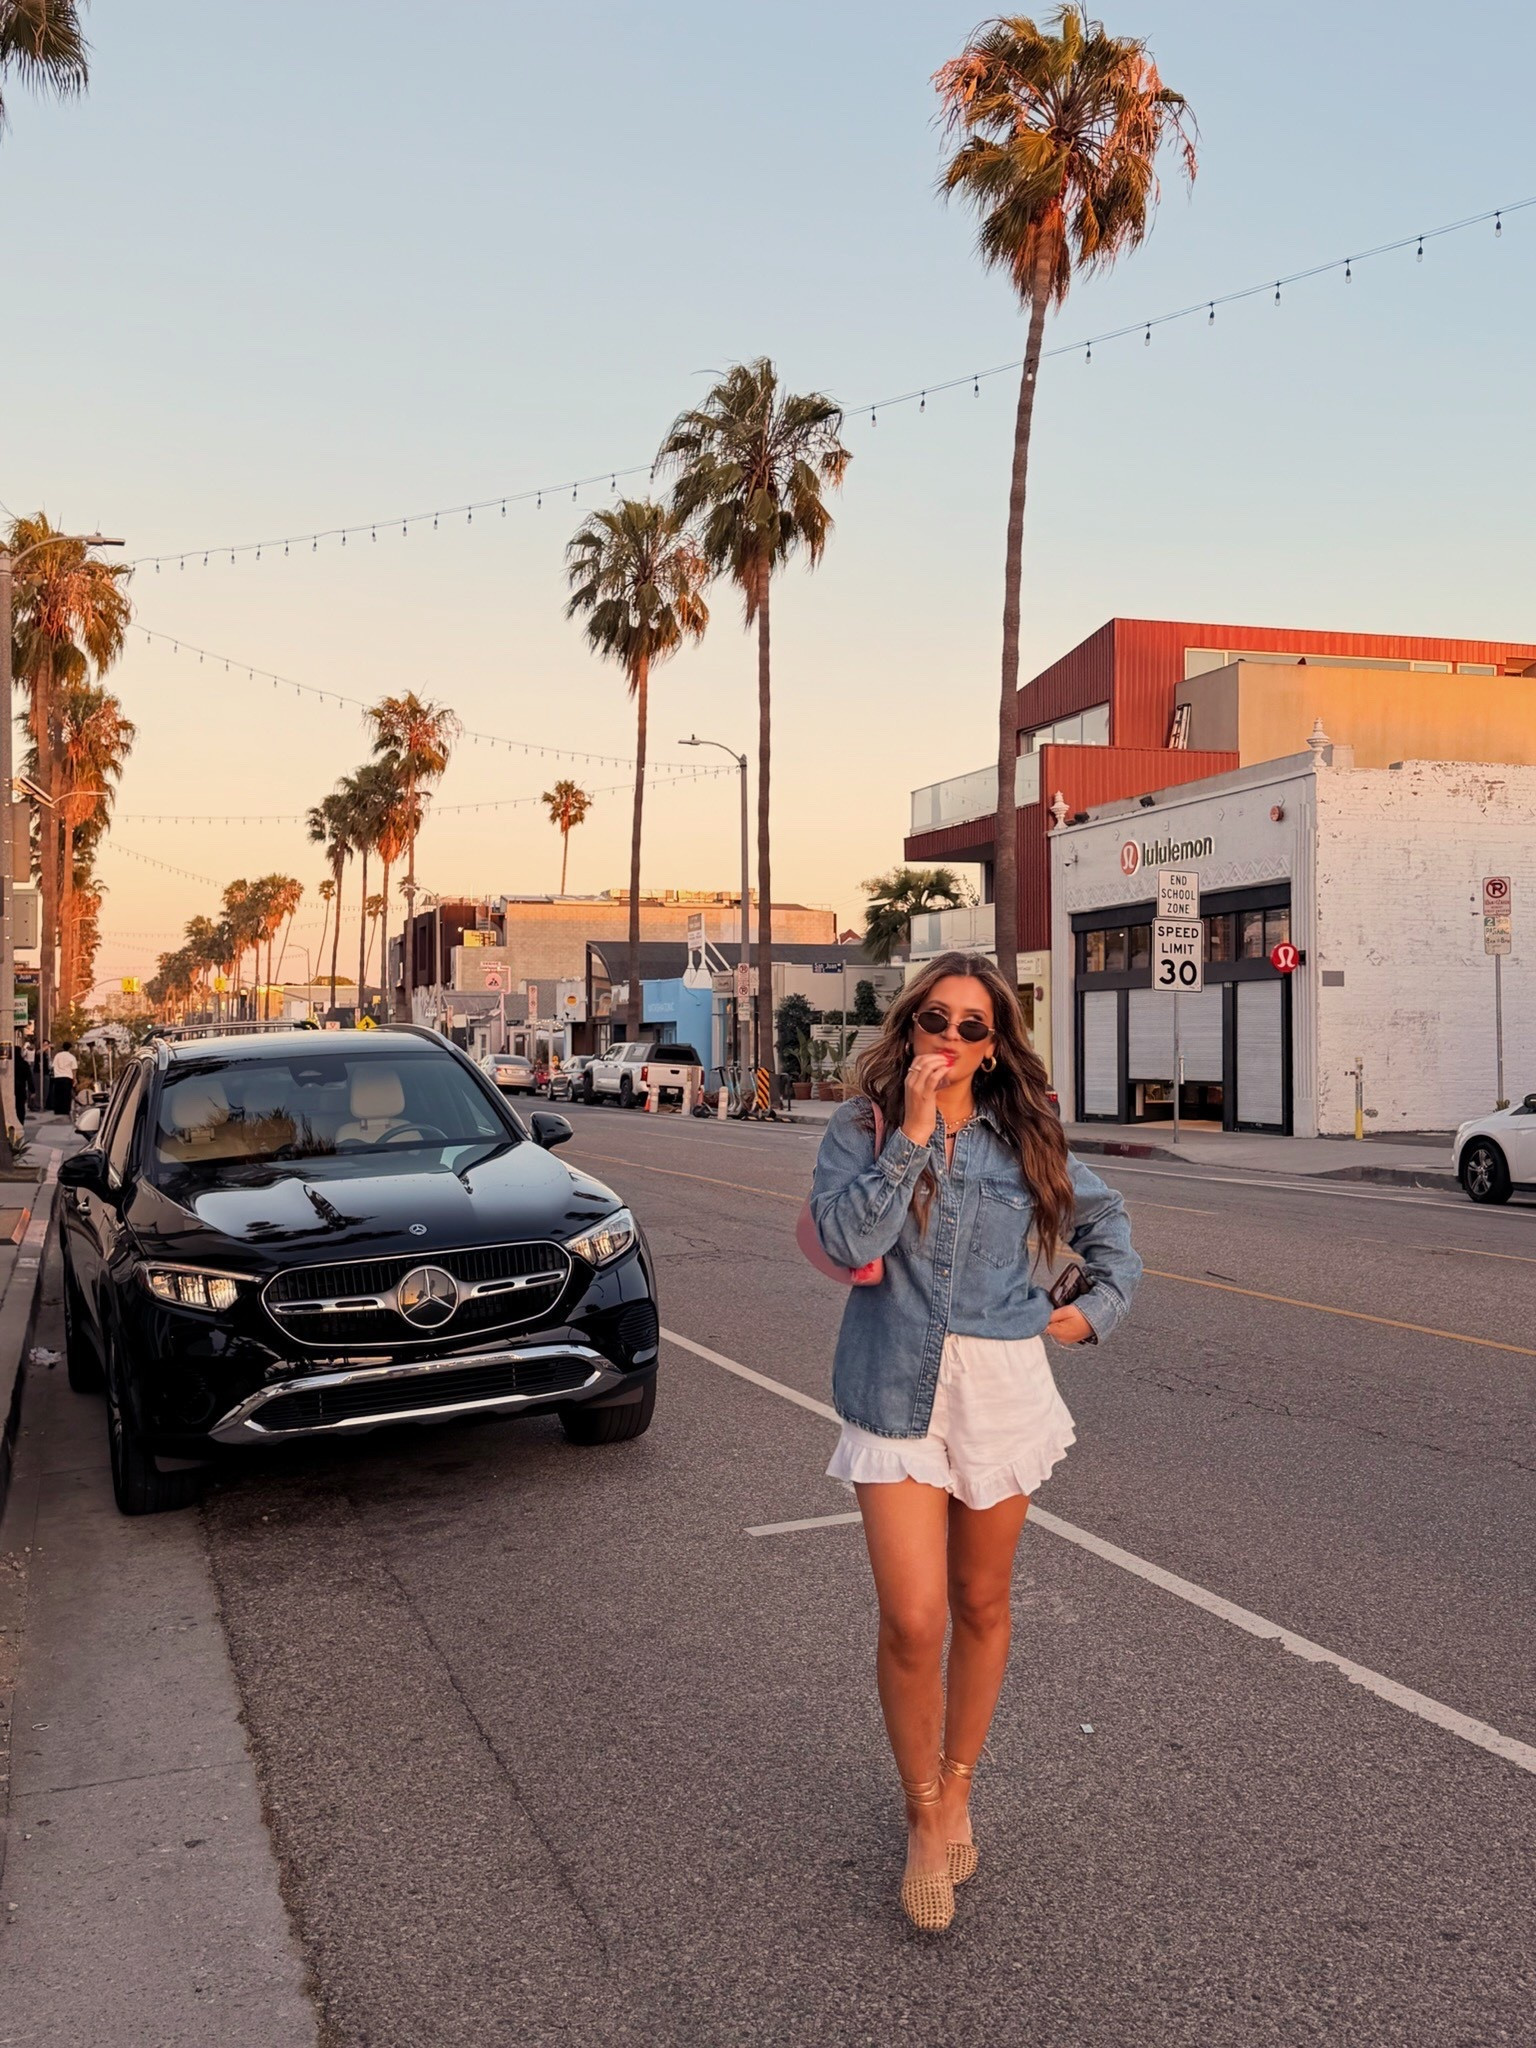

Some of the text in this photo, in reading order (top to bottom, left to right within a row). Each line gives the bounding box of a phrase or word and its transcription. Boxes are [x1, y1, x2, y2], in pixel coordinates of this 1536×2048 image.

[1142, 837, 1212, 867] lululemon
[1170, 875, 1187, 886] END
[1161, 888, 1196, 900] SCHOOL
[1167, 902, 1190, 914] ZONE
[1157, 926, 1199, 939] SPEED
[1161, 943, 1195, 955] LIMIT
[1159, 958, 1198, 986] 30
